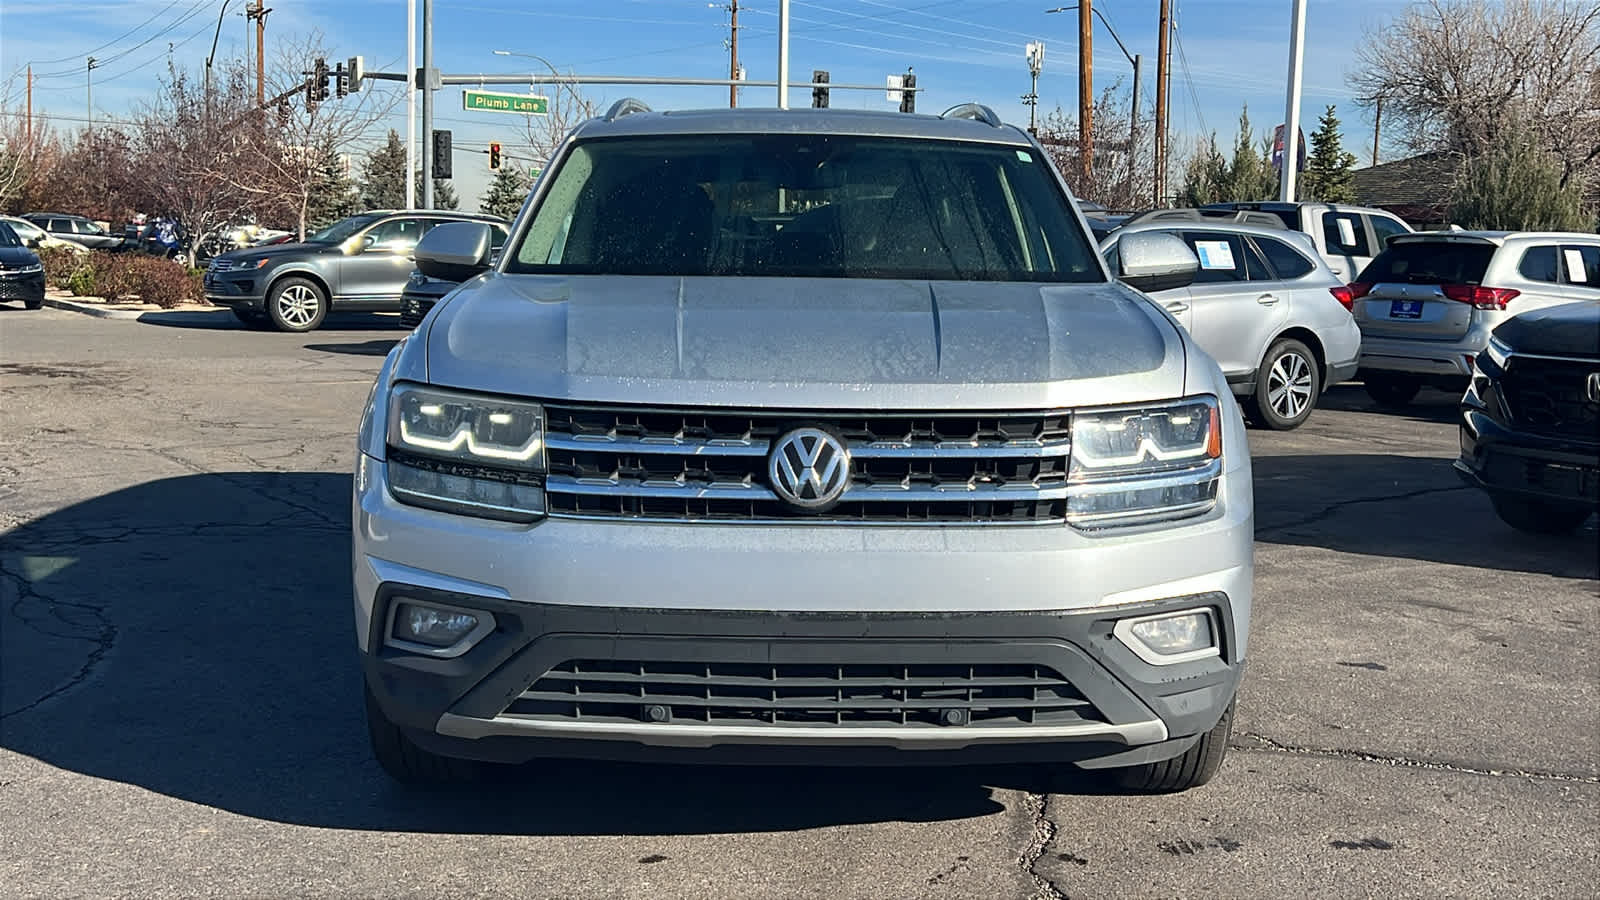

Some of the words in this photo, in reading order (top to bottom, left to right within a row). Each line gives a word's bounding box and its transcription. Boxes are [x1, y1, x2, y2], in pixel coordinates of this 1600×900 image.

[475, 96, 509, 108] Plumb
[513, 101, 539, 111] Lane
[772, 431, 846, 504] VW
